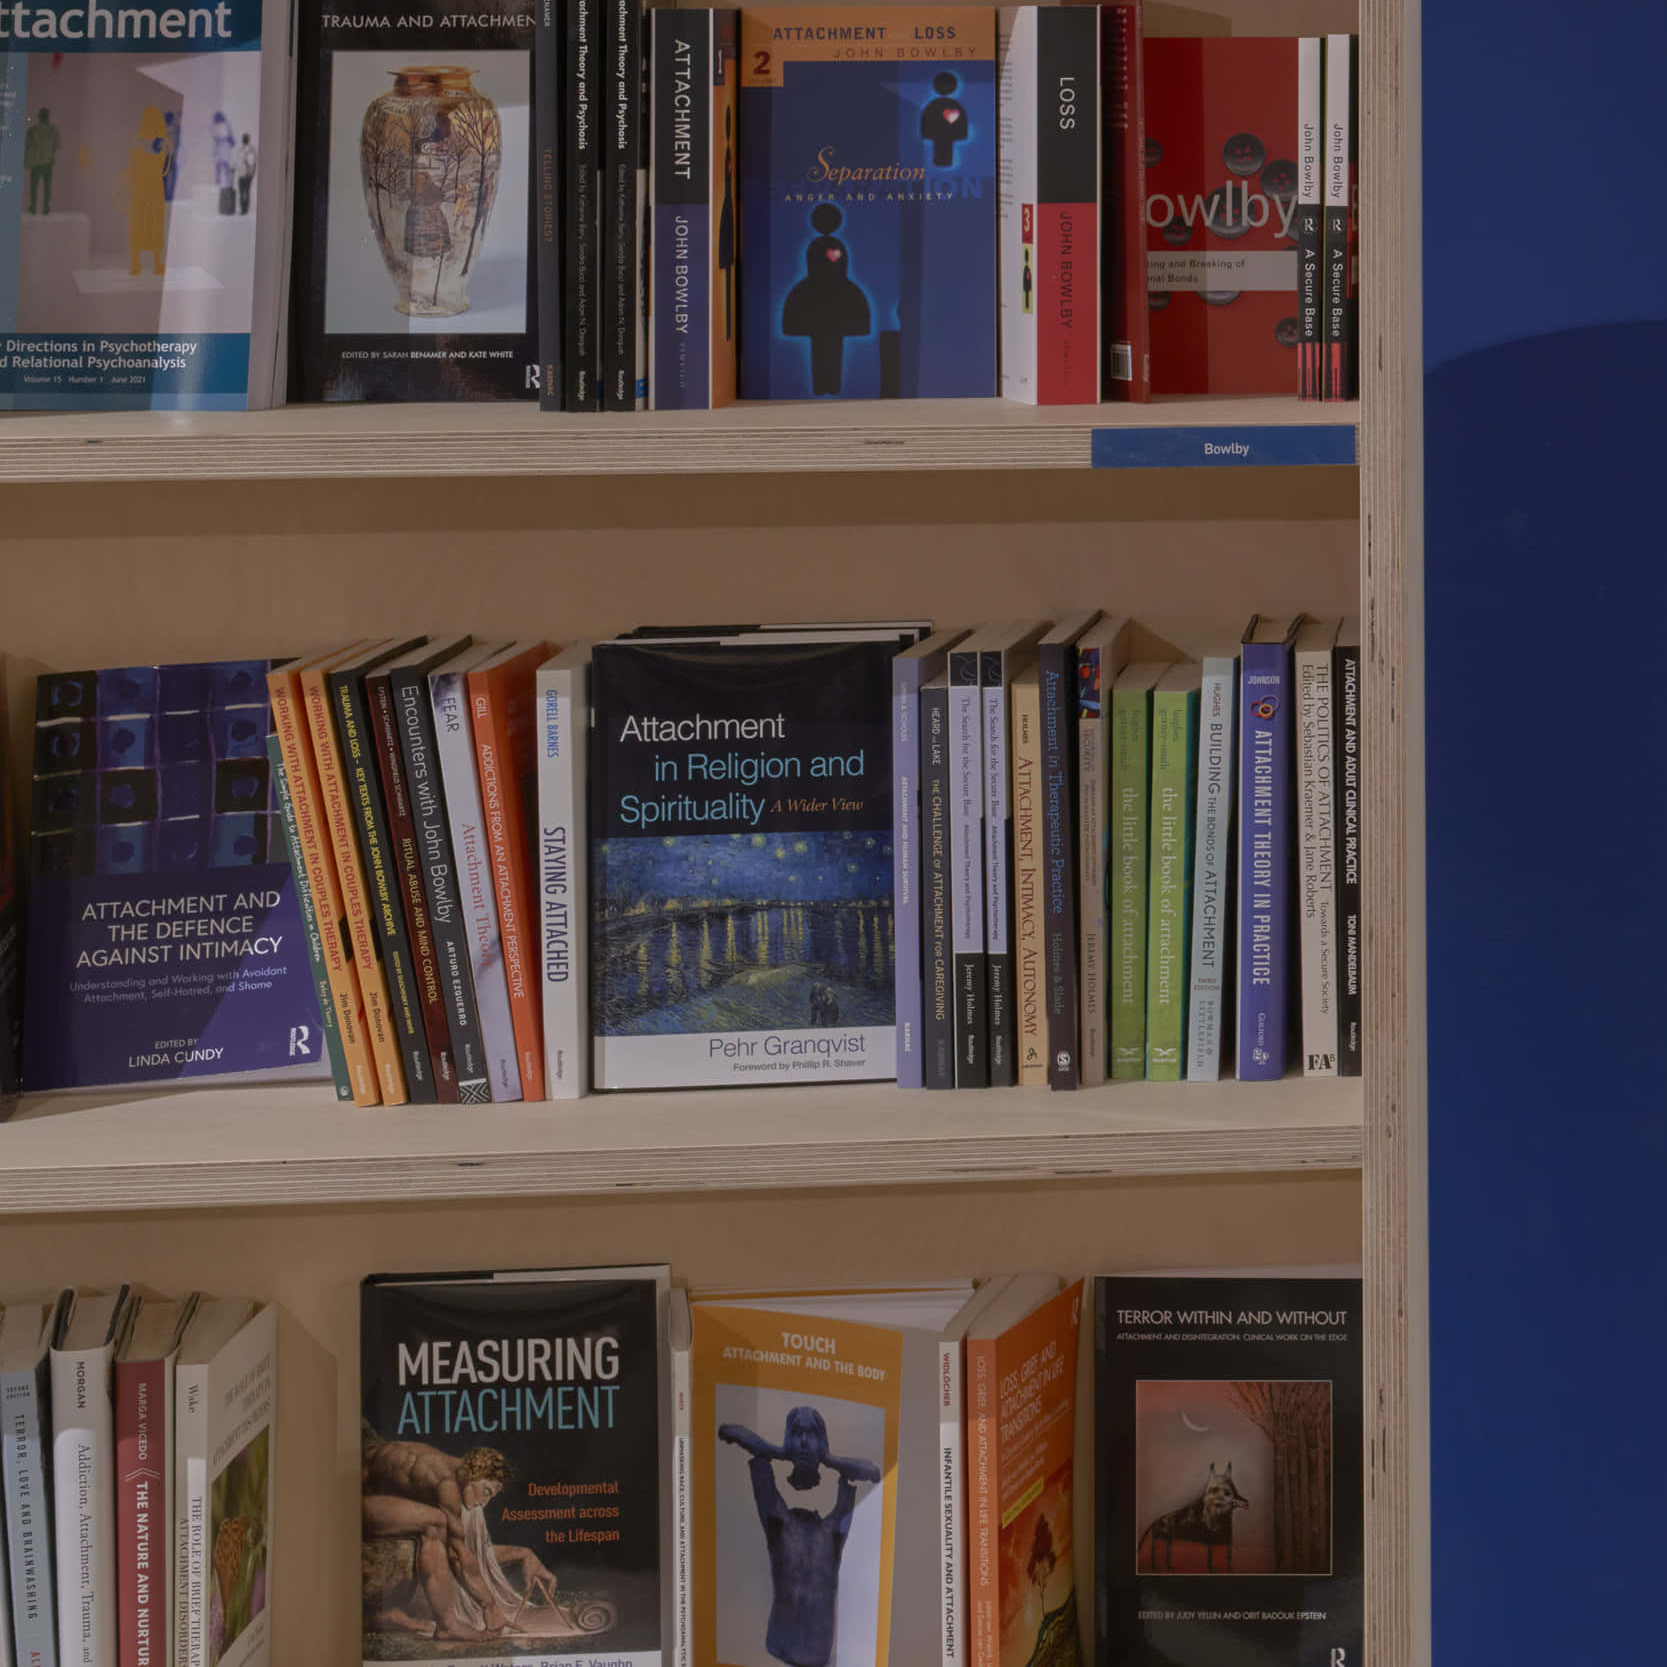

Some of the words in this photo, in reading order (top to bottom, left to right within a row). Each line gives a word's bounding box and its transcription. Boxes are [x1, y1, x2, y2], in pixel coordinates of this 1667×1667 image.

[322, 15, 391, 28] TRAUMA
[397, 15, 434, 28] AND
[440, 14, 536, 28] ATTACHMEN
[773, 27, 887, 40] ATTACHMENT
[914, 26, 957, 39] LOSS
[576, 45, 591, 79] Theory
[753, 51, 771, 74] 2
[833, 47, 884, 59] JOHN
[896, 47, 977, 58] BOWLBY
[578, 82, 588, 101] and
[1059, 76, 1076, 130] LOSS
[576, 103, 588, 150] Psychosis
[674, 39, 691, 180] ATTACHMENT
[1303, 123, 1314, 152] John
[808, 146, 925, 186] Separation
[1302, 156, 1314, 198] Bowlby
[846, 192, 875, 201] AND
[887, 192, 953, 201] ANXIETY
[1146, 179, 1298, 239] owlby
[675, 215, 689, 260] JOHN
[1024, 208, 1031, 232] 3
[1060, 211, 1073, 254] JOHN
[1305, 248, 1315, 258] A
[675, 265, 689, 334] BOWLBY
[1060, 262, 1073, 329] BOWLBY
[1305, 262, 1316, 307] Secure
[1305, 309, 1316, 337] Base
[6, 340, 78, 352] Directions
[82, 340, 95, 352] in
[100, 340, 198, 356] Psychotherapy
[12, 356, 83, 368] Relational
[88, 356, 187, 371] Psychoanalysis
[342, 351, 368, 359] EDITED
[370, 351, 381, 359] BY
[383, 351, 409, 359] SARAH
[410, 351, 447, 359] BENAMER
[449, 351, 468, 359] AND
[469, 351, 488, 359] KATE
[1204, 442, 1250, 458] Bowlby
[1248, 676, 1280, 685] JOHNSON
[275, 686, 295, 742] WORKING
[441, 697, 459, 733] FEAR
[475, 697, 488, 719] GILL
[546, 689, 557, 722] GORELL
[1213, 683, 1221, 717] HUGHES
[401, 685, 427, 780] Encounters
[546, 724, 559, 759] BARNES
[619, 712, 786, 743] Attachment
[287, 743, 301, 772] WITH
[655, 754, 678, 782] in
[688, 751, 801, 786] Religion
[809, 749, 864, 778] and
[1207, 723, 1223, 794] BUILDING
[1254, 730, 1272, 826] ATTACHMENT
[293, 774, 317, 848] ATTACHMENT
[415, 782, 437, 817] with
[620, 791, 766, 830] Spirituality
[770, 800, 782, 813] A
[788, 798, 828, 812] Wider
[832, 798, 864, 812] View
[1018, 757, 1034, 861] ATTACHMENT,
[1207, 796, 1217, 815] THE
[424, 819, 442, 861] John
[1206, 817, 1216, 852] BONDS
[309, 852, 320, 866] IN
[543, 826, 568, 896] STAYING
[1205, 853, 1214, 866] OF
[1252, 831, 1272, 888] THEORY
[81, 894, 228, 921] ATTACHMENT
[233, 891, 281, 911] AND
[311, 867, 332, 918] COUPLES
[429, 863, 452, 924] Bowlby
[461, 822, 486, 910] Attachment
[475, 911, 494, 968] Theory
[1020, 866, 1036, 941] INTIMACY,
[1253, 894, 1272, 909] IN
[107, 923, 150, 942] THE
[156, 916, 254, 940] DEFENCE
[1202, 870, 1217, 968] ATTACHMENT
[75, 945, 174, 969] AGAINST
[179, 936, 283, 961] INTIMACY
[323, 919, 344, 972] THERAPY
[544, 901, 569, 982] ATTACHED
[1253, 915, 1272, 985] PRACTICE
[445, 941, 458, 978] ARTURO
[70, 976, 146, 992] Understanding
[148, 975, 169, 986] and
[172, 972, 214, 986] Working
[216, 970, 240, 980] with
[242, 965, 288, 979] Avoidant
[1022, 947, 1038, 1037] AUTONOMY
[451, 978, 467, 1026] EZQUERRO
[128, 1055, 170, 1068] LINDA
[174, 1048, 224, 1063] CUNDY
[154, 1039, 186, 1050] EDITED
[187, 1038, 199, 1047] BY
[709, 1038, 758, 1058] Pehr
[764, 1034, 865, 1058] Granqvist
[1117, 1310, 1173, 1325] TERROR
[1176, 1310, 1233, 1325] WITHIN
[1236, 1311, 1272, 1325] AND
[1275, 1310, 1348, 1325] WITHOUT
[398, 1336, 621, 1386] MEASURING
[781, 1332, 837, 1355] TOUCH
[722, 1346, 803, 1368] ATTACHMENT
[805, 1357, 832, 1371] AND
[834, 1361, 855, 1376] THE
[857, 1365, 887, 1382] BODY
[76, 1361, 88, 1409] MORGAN
[397, 1385, 621, 1435] ATTACHMENT
[136, 1481, 149, 1510] THE
[527, 1482, 620, 1499] Developmental
[502, 1506, 577, 1523] Assessment
[578, 1506, 620, 1519] across
[136, 1513, 149, 1569] NATURE
[545, 1530, 566, 1543] the
[568, 1529, 620, 1545] Lifespan
[136, 1570, 149, 1606] AND
